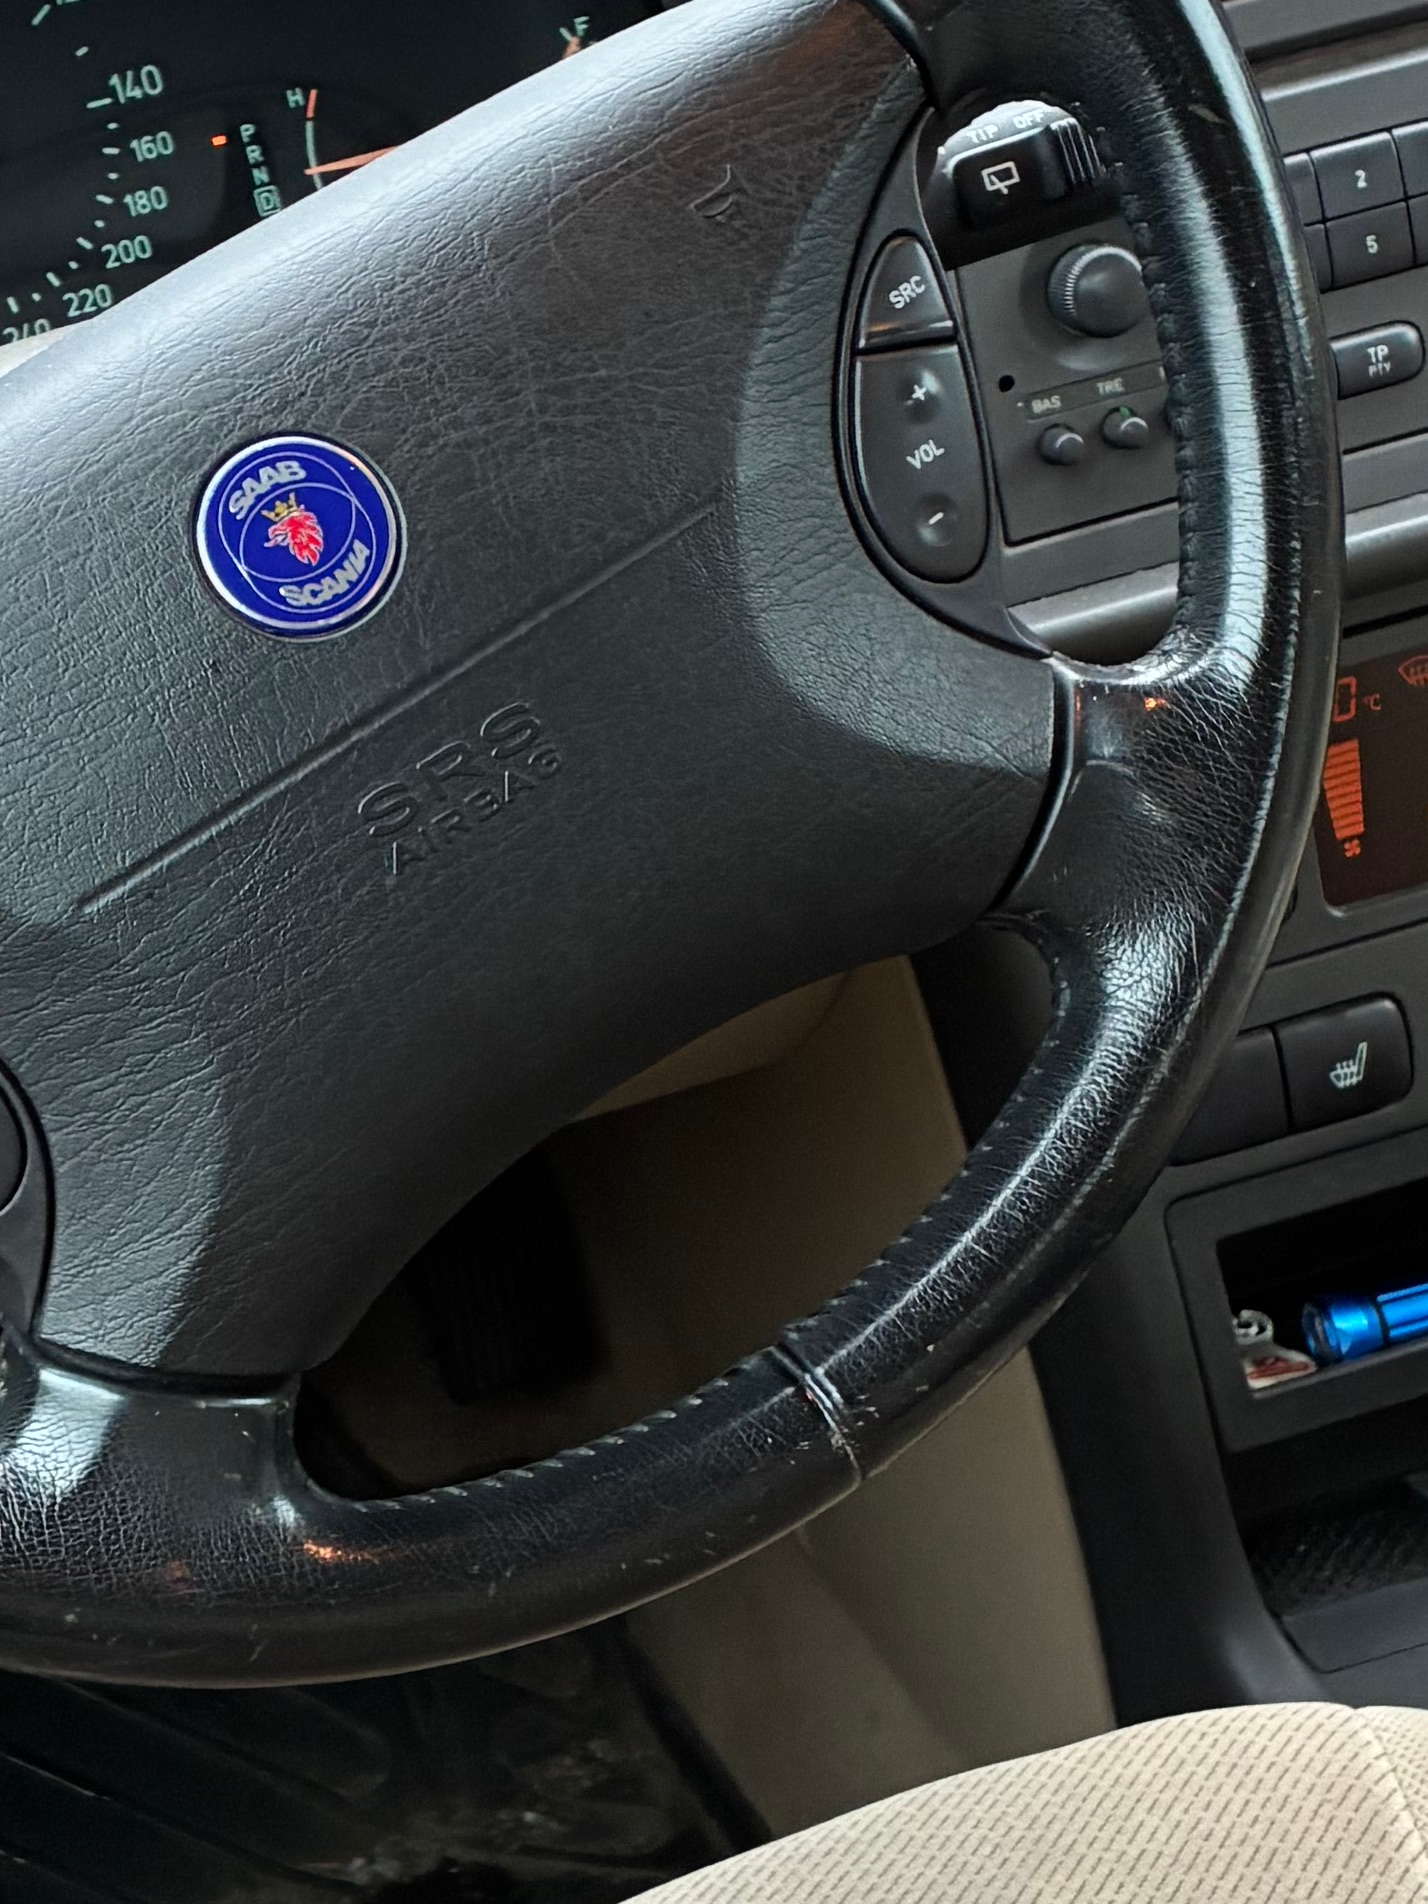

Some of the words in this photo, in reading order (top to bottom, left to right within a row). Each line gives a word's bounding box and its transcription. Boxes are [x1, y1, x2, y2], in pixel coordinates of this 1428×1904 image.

[573, 16, 590, 36] F
[108, 64, 165, 104] 140
[286, 87, 306, 108] H
[239, 123, 256, 142] P
[965, 123, 999, 143] TIP
[1013, 111, 1045, 129] OFF
[129, 130, 175, 163] 160
[246, 145, 264, 164] R
[1355, 169, 1367, 189] 2
[123, 185, 169, 217] 180
[100, 234, 153, 269] 200
[1366, 235, 1378, 255] 5
[62, 283, 113, 317] 220
[889, 275, 926, 310] SRC
[1367, 344, 1389, 363] TP
[1031, 395, 1062, 414] BAS
[906, 439, 946, 470] VOL
[228, 460, 308, 521] SAAB
[278, 539, 371, 607] SCANIA
[357, 701, 541, 839] SRS
[383, 745, 563, 876] AIRBAG
